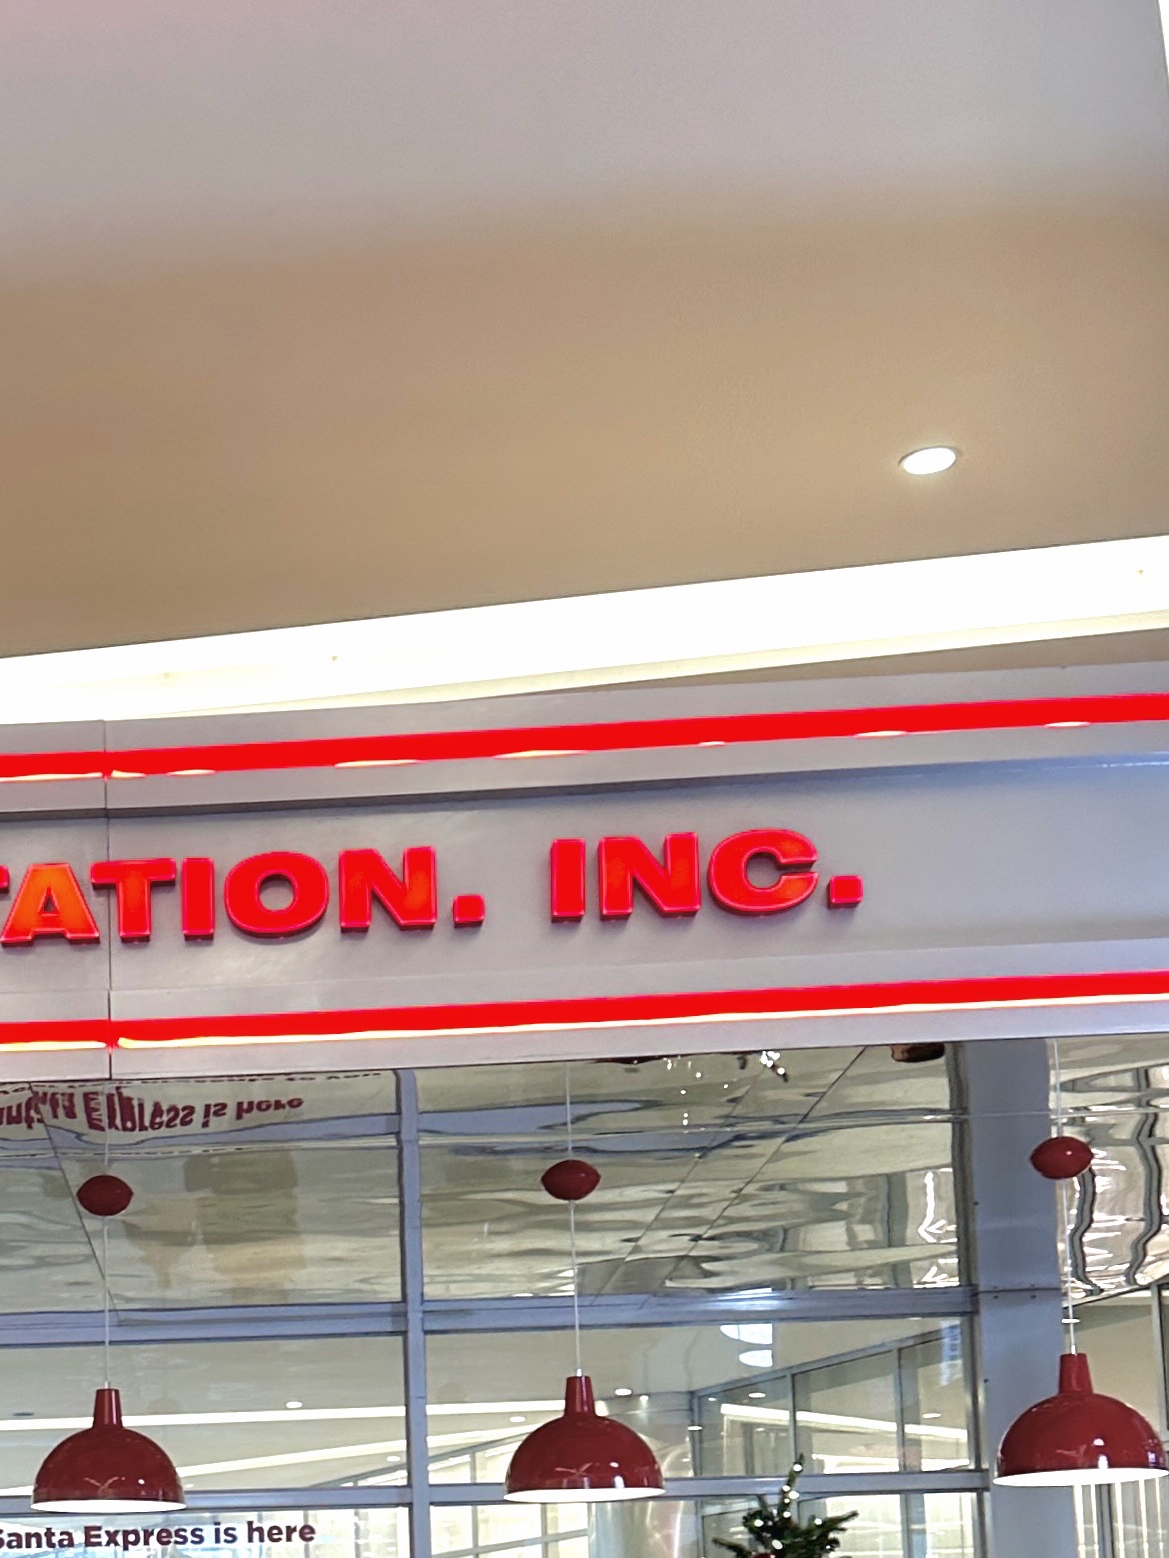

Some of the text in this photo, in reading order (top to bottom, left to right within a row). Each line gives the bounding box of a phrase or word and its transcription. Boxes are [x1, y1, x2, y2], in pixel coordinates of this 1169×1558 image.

[550, 828, 864, 923] INC.
[84, 1524, 205, 1552] Express
[213, 1521, 238, 1545] is
[247, 1520, 316, 1544] here
